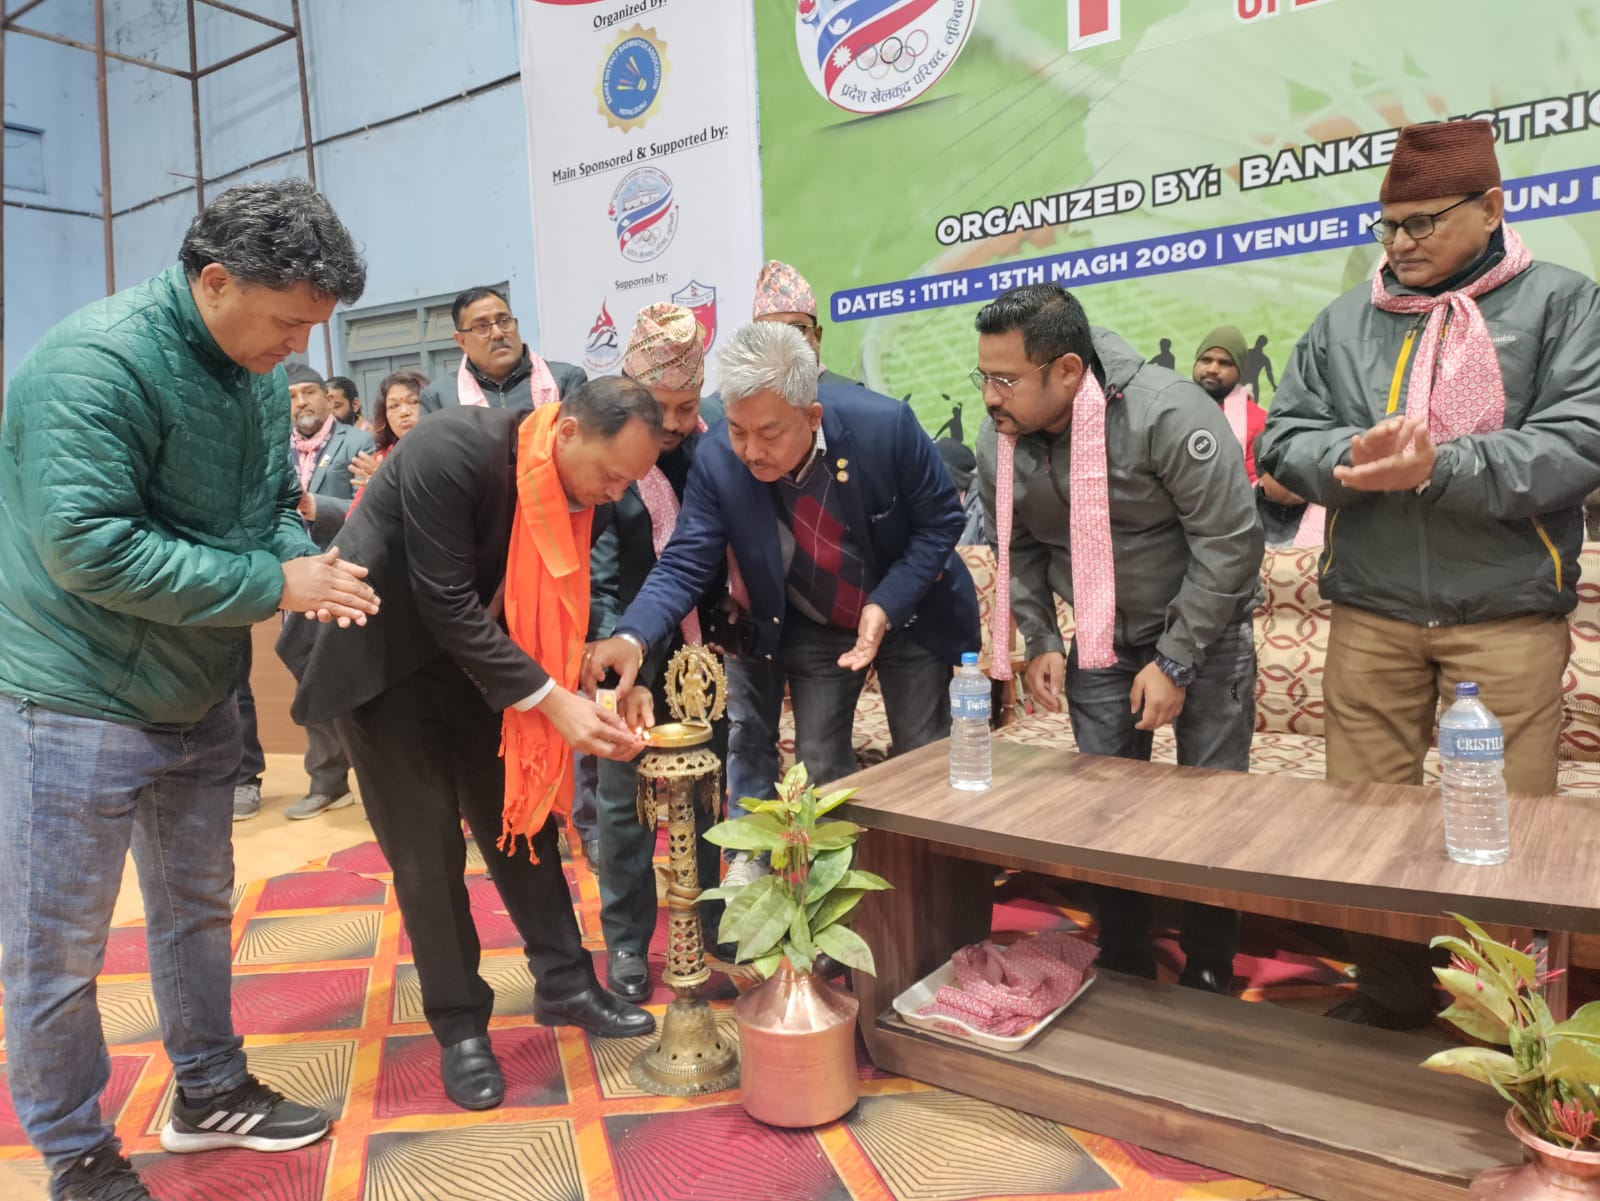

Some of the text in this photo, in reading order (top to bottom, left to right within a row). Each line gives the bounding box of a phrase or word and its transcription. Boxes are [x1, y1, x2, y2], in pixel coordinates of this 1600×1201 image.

[593, 0, 647, 27] Organized
[840, 83, 868, 103] प्रदेश
[552, 125, 728, 183] Main Sponsored & Supported by:
[935, 180, 1144, 245] ORGANIZED
[1152, 163, 1221, 207] BY:
[1239, 128, 1399, 191] BANKE
[615, 272, 669, 290] Supported by:
[921, 277, 967, 303] 11TH
[989, 265, 1043, 291] 13TH
[1052, 252, 1127, 282] MAGH
[1135, 239, 1206, 266] 2080
[1233, 217, 1348, 253] VENUE:
